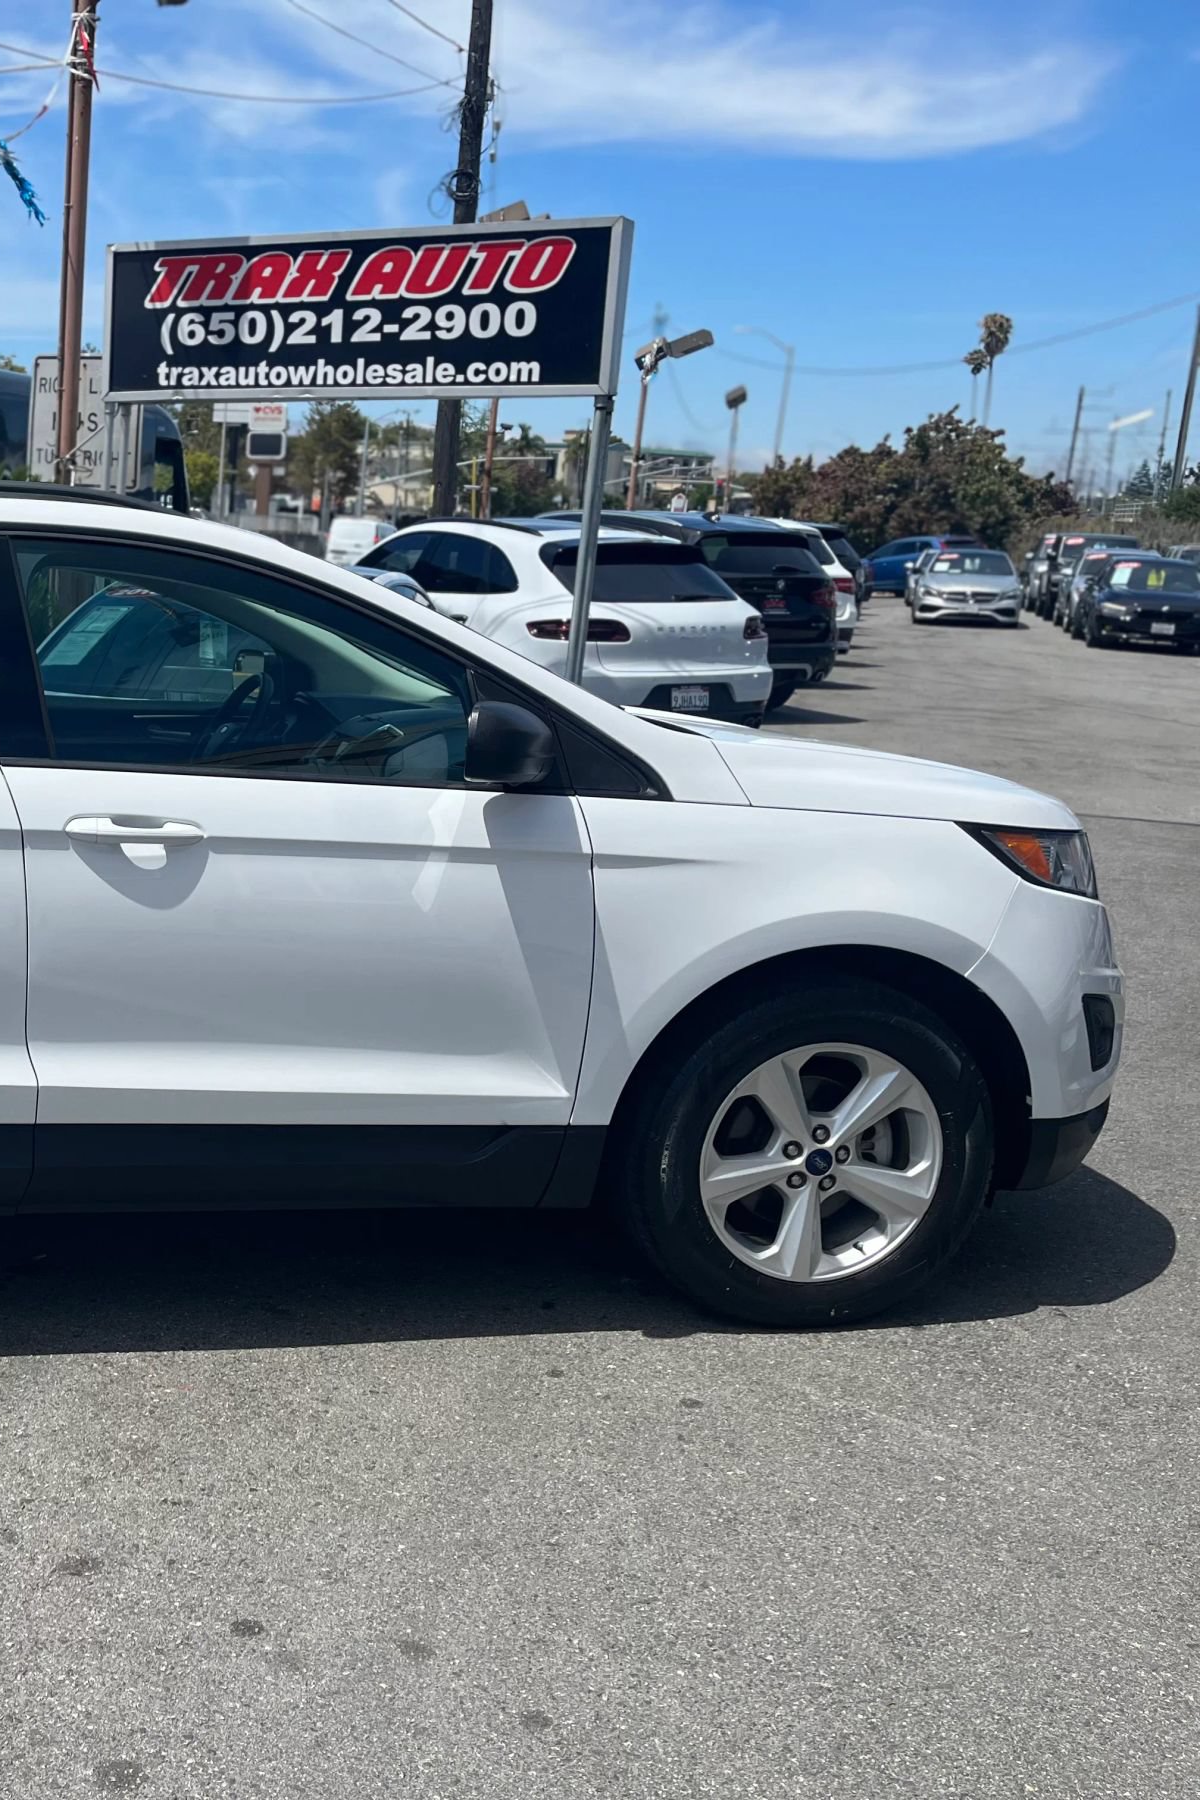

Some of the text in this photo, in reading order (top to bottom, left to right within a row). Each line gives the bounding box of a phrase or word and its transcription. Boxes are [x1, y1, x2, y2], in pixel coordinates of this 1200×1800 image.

[144, 235, 577, 309] TRAX AUTO
[160, 300, 538, 356] (650)212-2900
[156, 355, 541, 387] traxautowholesale.com
